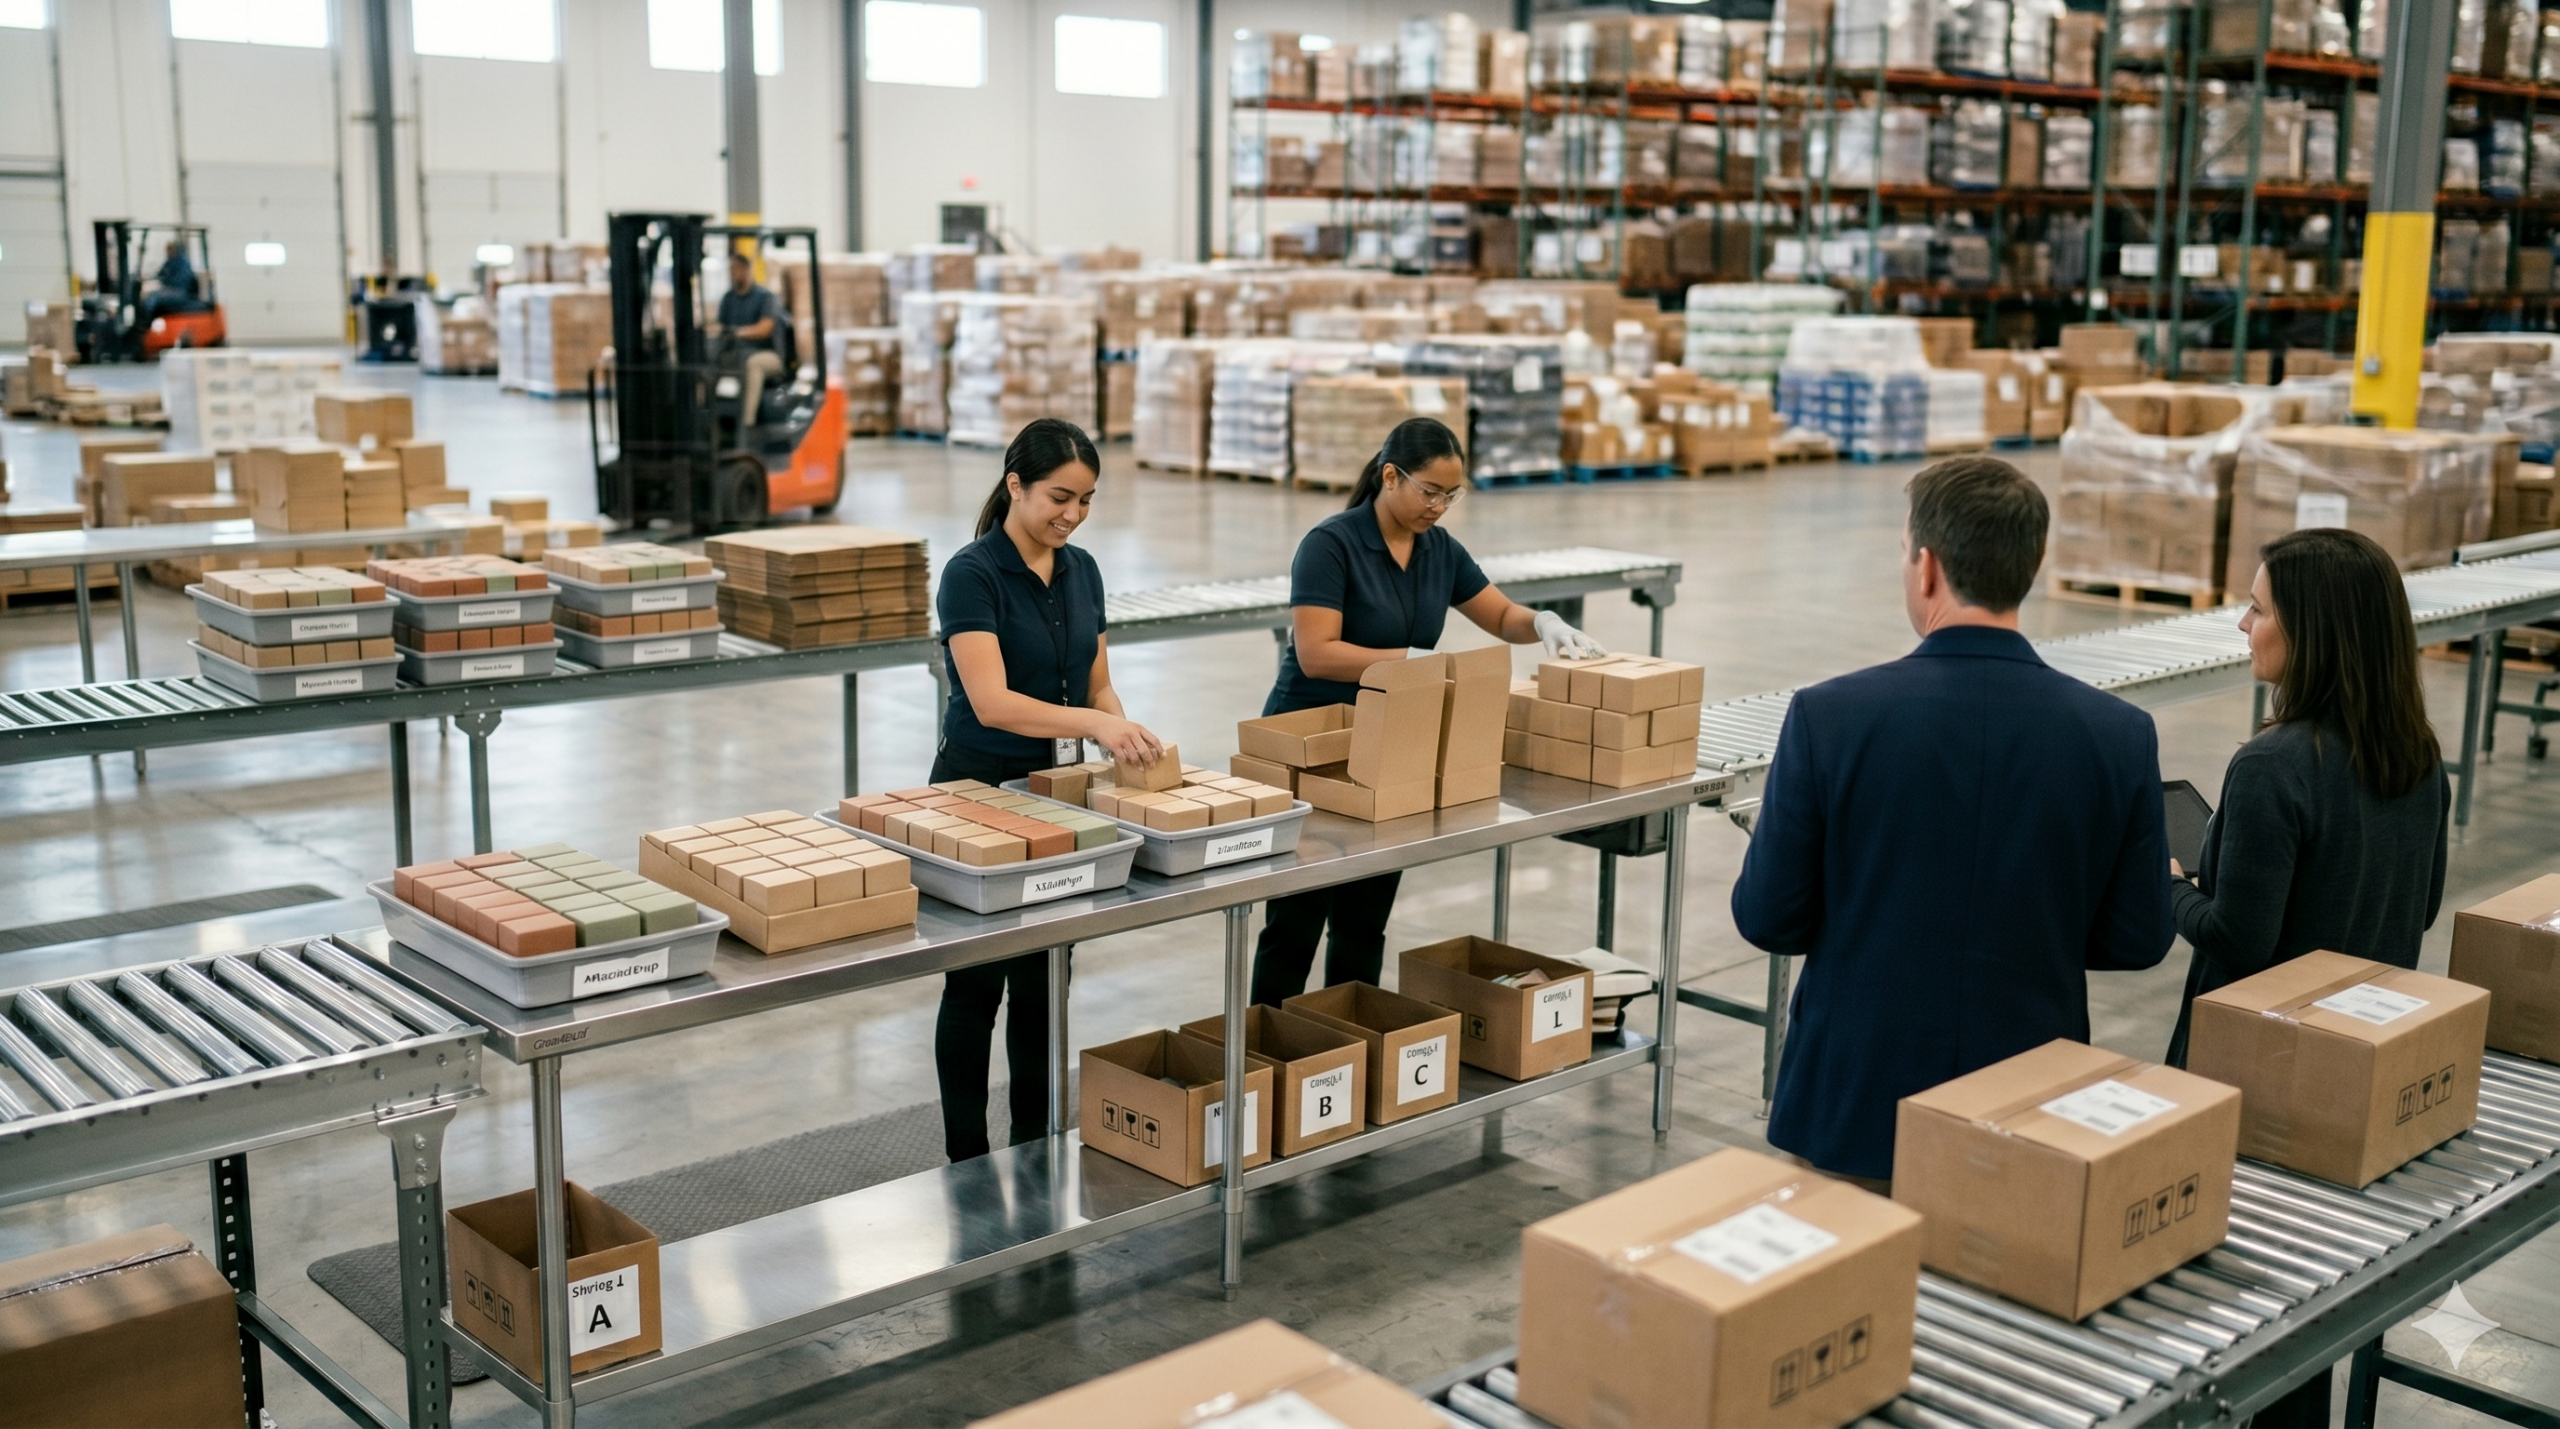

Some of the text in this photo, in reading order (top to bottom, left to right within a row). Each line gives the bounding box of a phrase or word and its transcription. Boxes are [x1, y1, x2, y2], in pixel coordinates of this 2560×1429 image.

[1553, 1011, 1563, 1029] L
[1414, 1064, 1429, 1086] C
[1319, 1095, 1333, 1118] B
[589, 1304, 612, 1333] A
